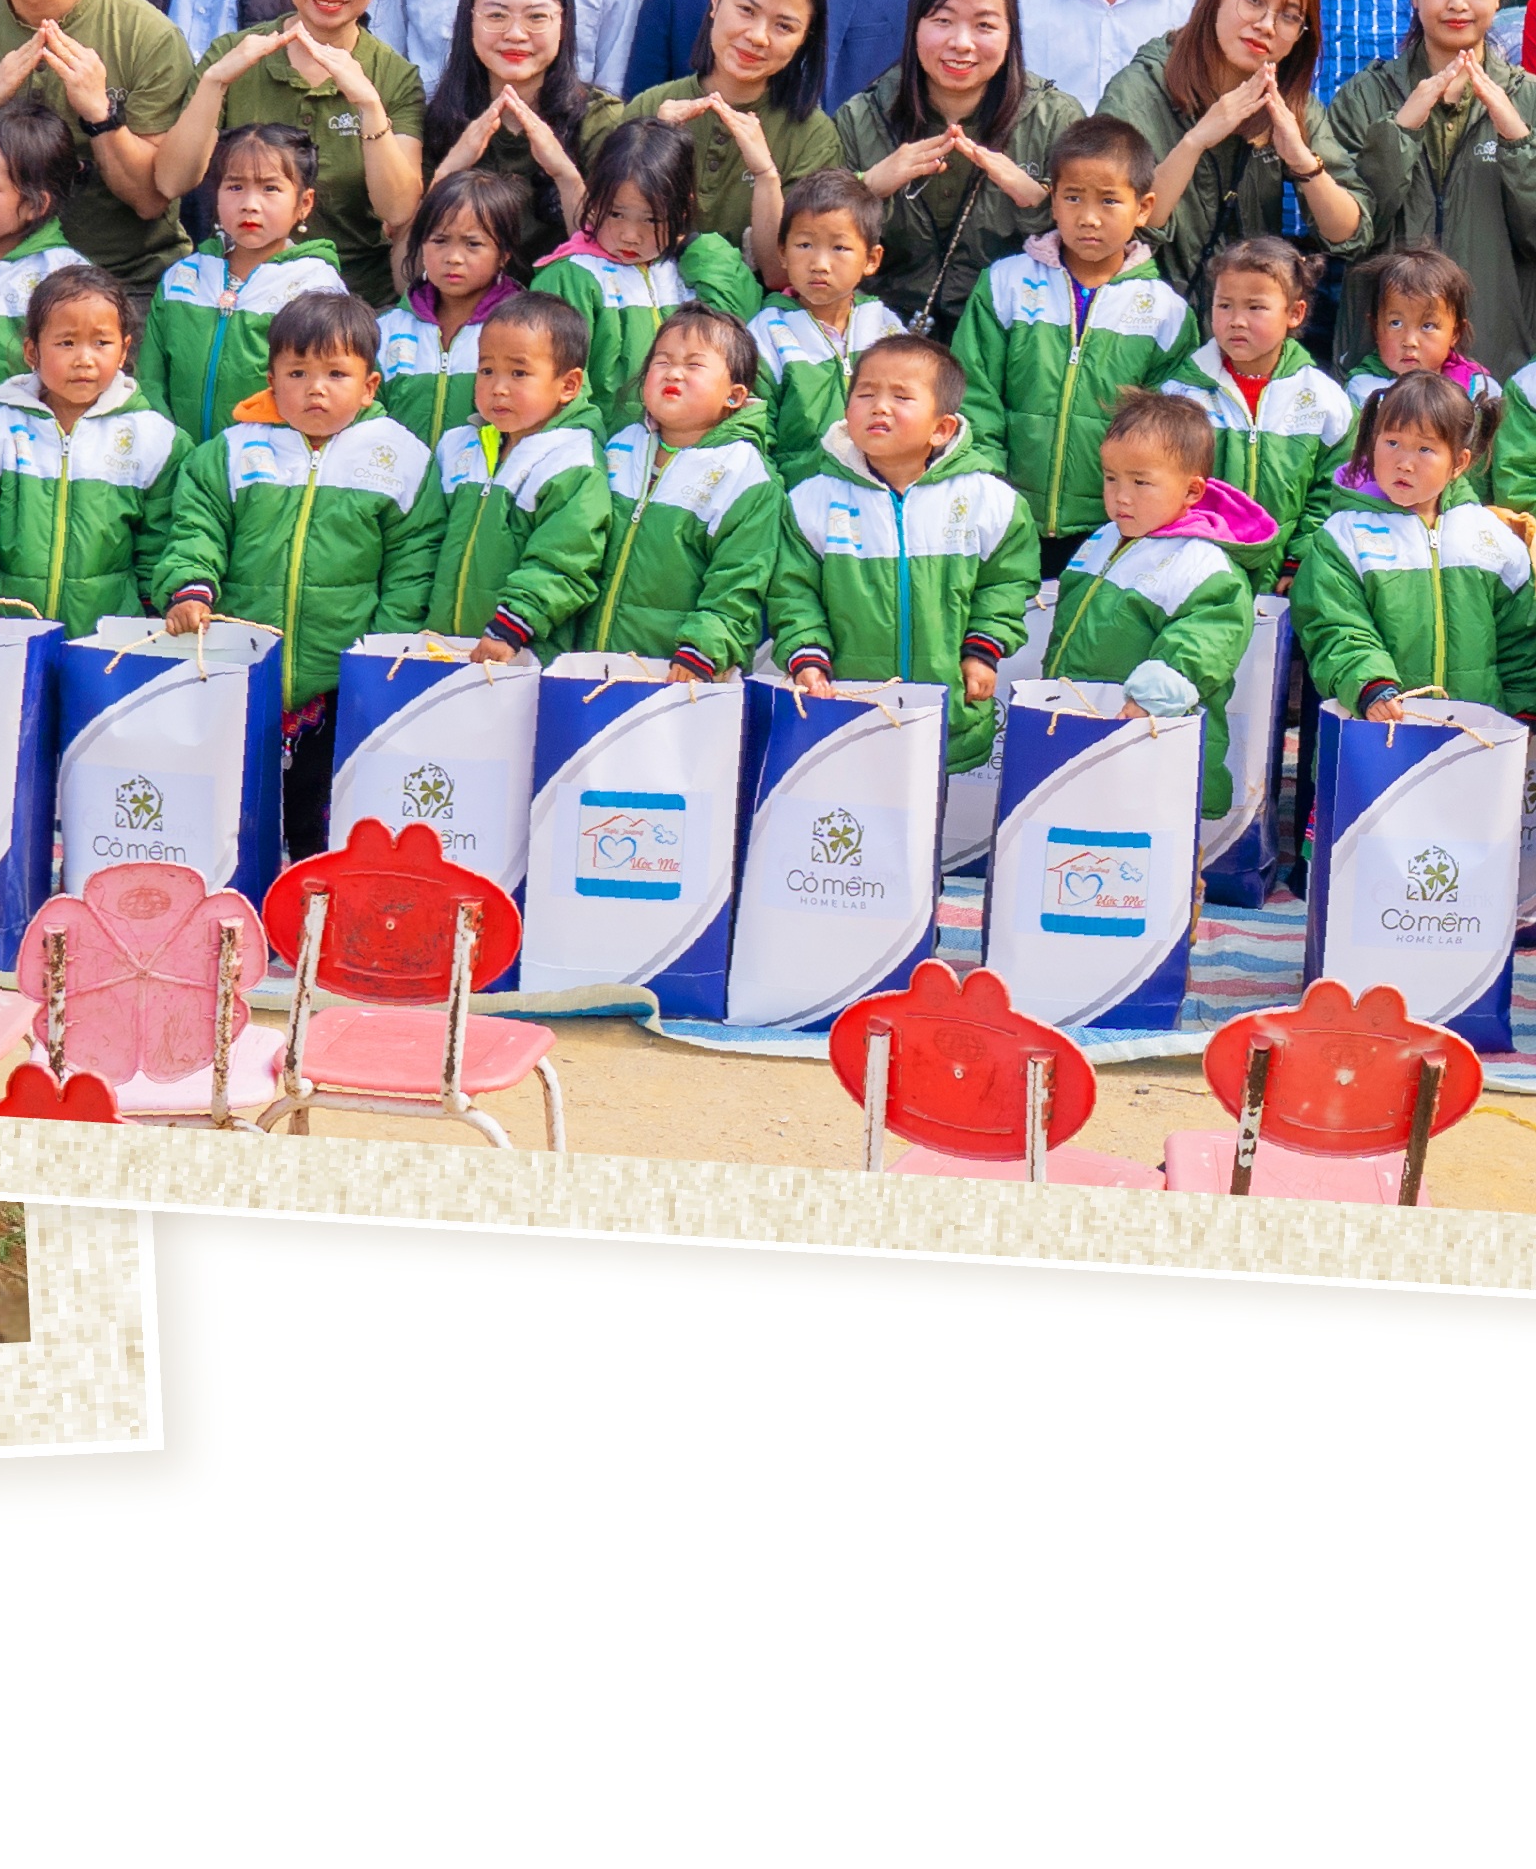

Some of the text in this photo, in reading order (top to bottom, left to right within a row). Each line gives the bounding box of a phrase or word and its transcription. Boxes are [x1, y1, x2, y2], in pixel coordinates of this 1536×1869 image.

[93, 835, 186, 863] Cỏ mềm
[786, 869, 885, 899] Cỏ mềm
[800, 896, 867, 910] HOME LAB
[1381, 908, 1480, 933] Cỏ mềm
[1396, 934, 1463, 945] HOME LAB
